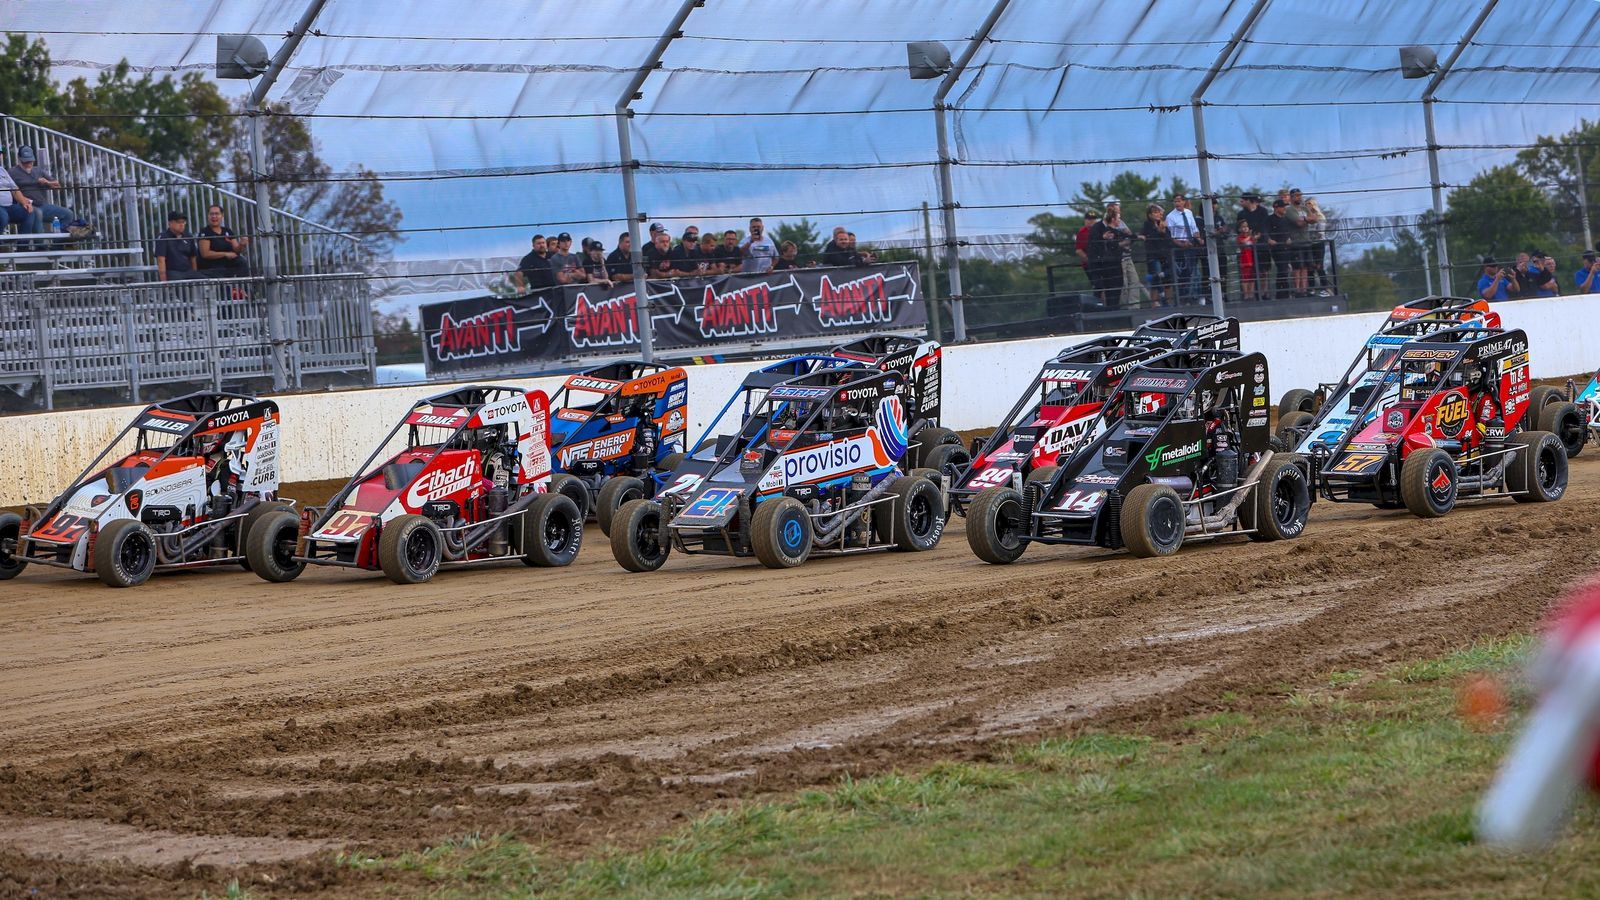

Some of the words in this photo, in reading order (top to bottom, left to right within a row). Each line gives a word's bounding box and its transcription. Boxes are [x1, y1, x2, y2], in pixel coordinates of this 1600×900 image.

[817, 270, 889, 322] AVANTI
[700, 281, 771, 331] AVANTI
[439, 307, 515, 354] AVANTI
[886, 355, 912, 370] TOYOTA
[1404, 351, 1457, 359] SEAVEY
[639, 376, 665, 389] TOYOTA
[1041, 369, 1092, 381] WIGAL
[569, 377, 619, 391] GRANT
[846, 387, 878, 401] TOYOTA
[495, 401, 528, 418] TOYOTA
[920, 398, 938, 413] CURB
[1436, 400, 1468, 427] FUEL
[142, 418, 189, 431] MILLER
[215, 410, 250, 428] TOYOTA
[416, 415, 458, 425] DRAKE
[257, 443, 270, 452] Mobil
[594, 433, 631, 450] ENERGY
[592, 445, 622, 459] DRINK
[1162, 441, 1199, 461] metalloid
[785, 439, 861, 488] provisio
[1333, 455, 1383, 471] 57
[253, 471, 275, 486] CURB
[407, 456, 475, 508] Eibach
[766, 480, 779, 488] Mobil
[145, 479, 193, 497] SOUNDGEAR
[432, 504, 450, 512] TRD
[1054, 490, 1104, 511] 14
[42, 514, 91, 538] 97
[322, 514, 371, 537] 97
